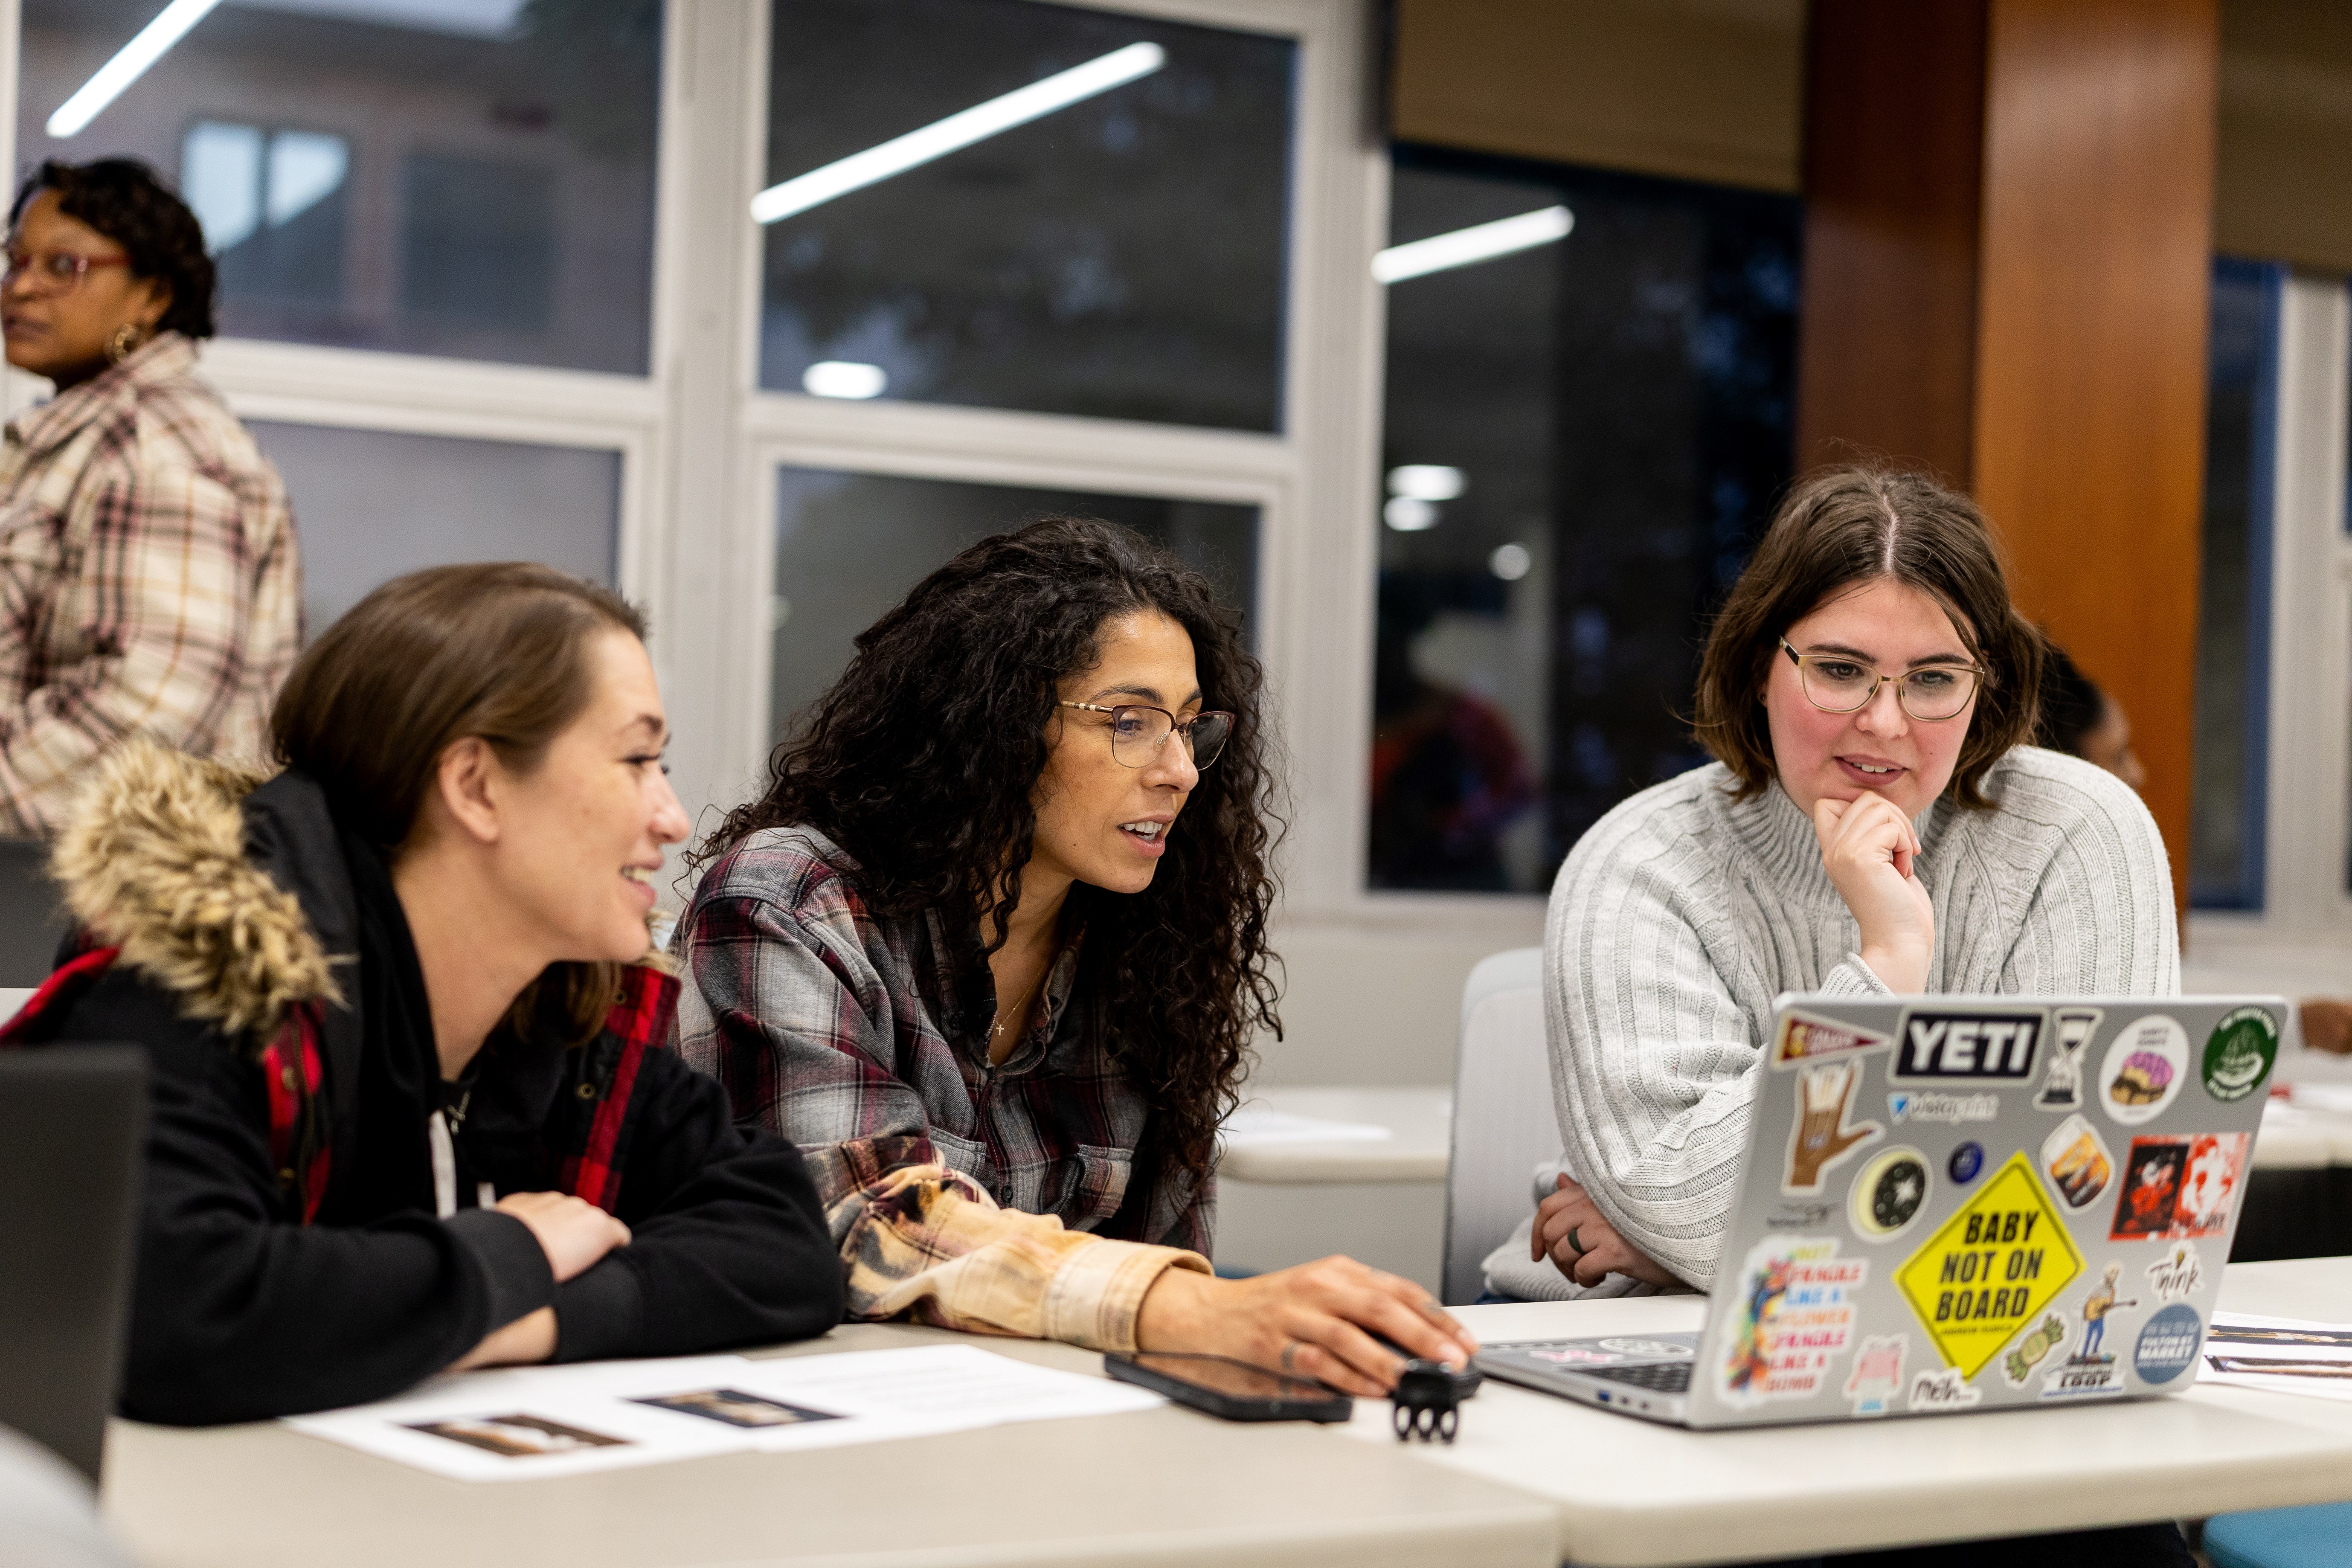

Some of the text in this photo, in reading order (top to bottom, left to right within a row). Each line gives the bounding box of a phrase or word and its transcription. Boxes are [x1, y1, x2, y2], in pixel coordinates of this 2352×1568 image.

[1908, 1020, 2033, 1072] YETI
[1965, 1211, 2039, 1245] BABY
[1940, 1249, 2044, 1283] NOT ON
[1935, 1287, 2030, 1321] BOARD
